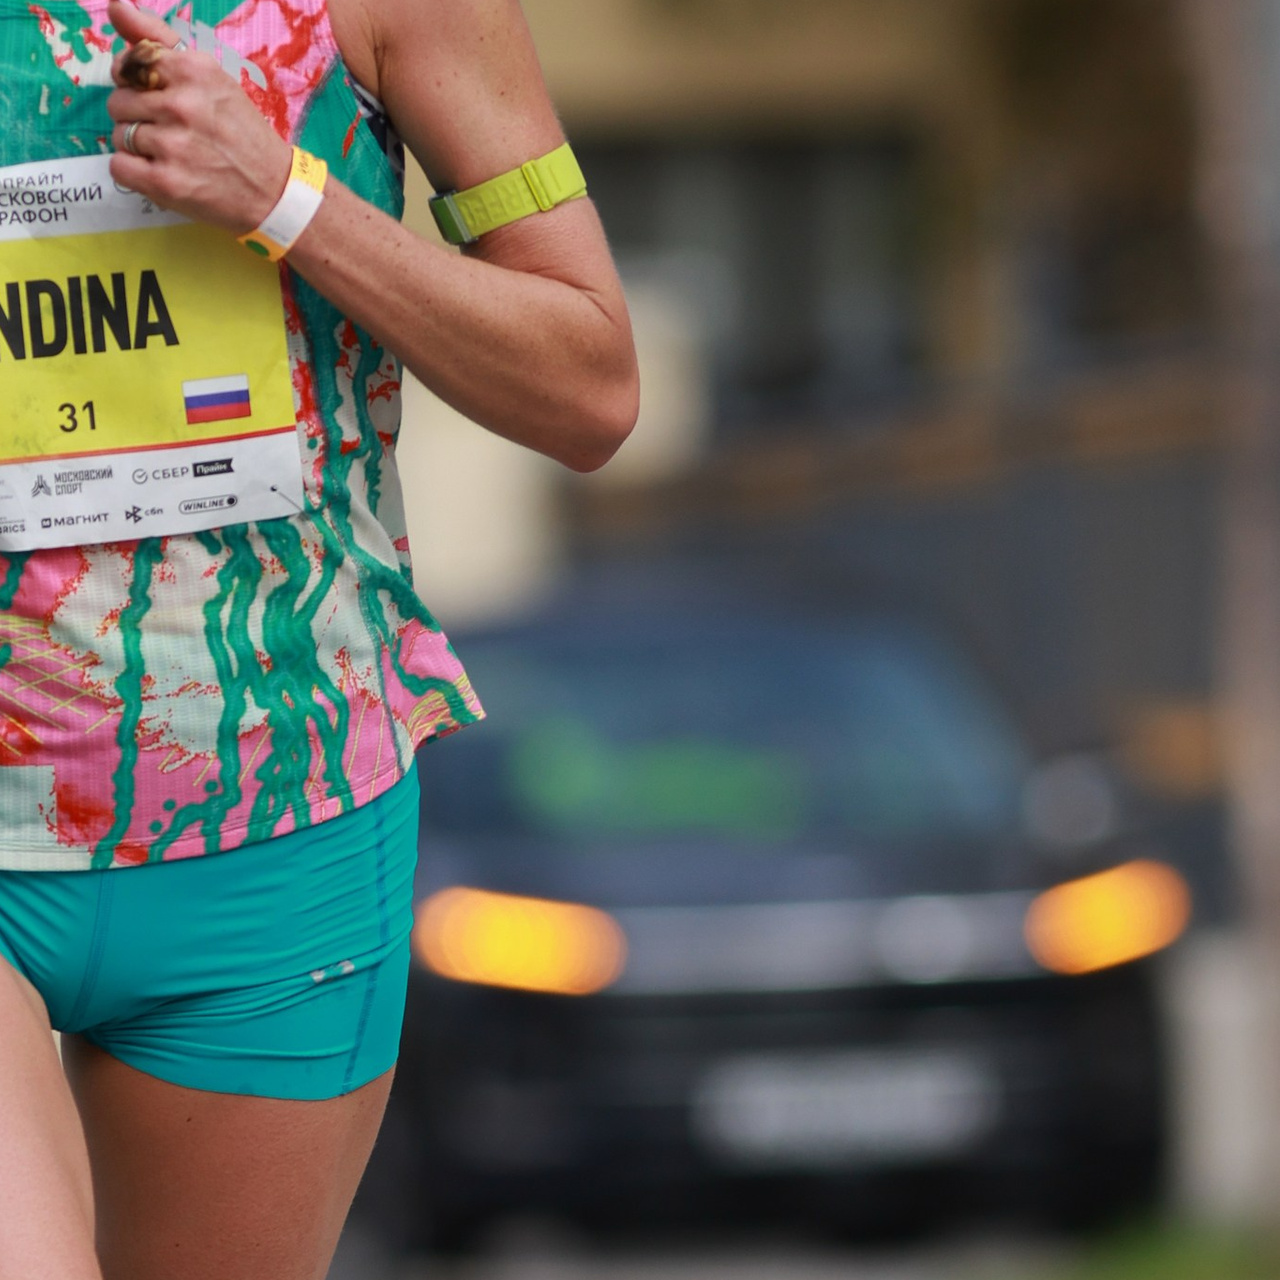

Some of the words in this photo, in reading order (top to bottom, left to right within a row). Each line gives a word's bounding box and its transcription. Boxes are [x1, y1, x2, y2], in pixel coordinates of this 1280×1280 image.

[58, 400, 97, 433] 31
[53, 465, 113, 483] МОСКОВСКИЙ
[151, 466, 190, 481] СБЕР
[55, 482, 83, 496] СПОРТ
[183, 499, 225, 511] WINLINE
